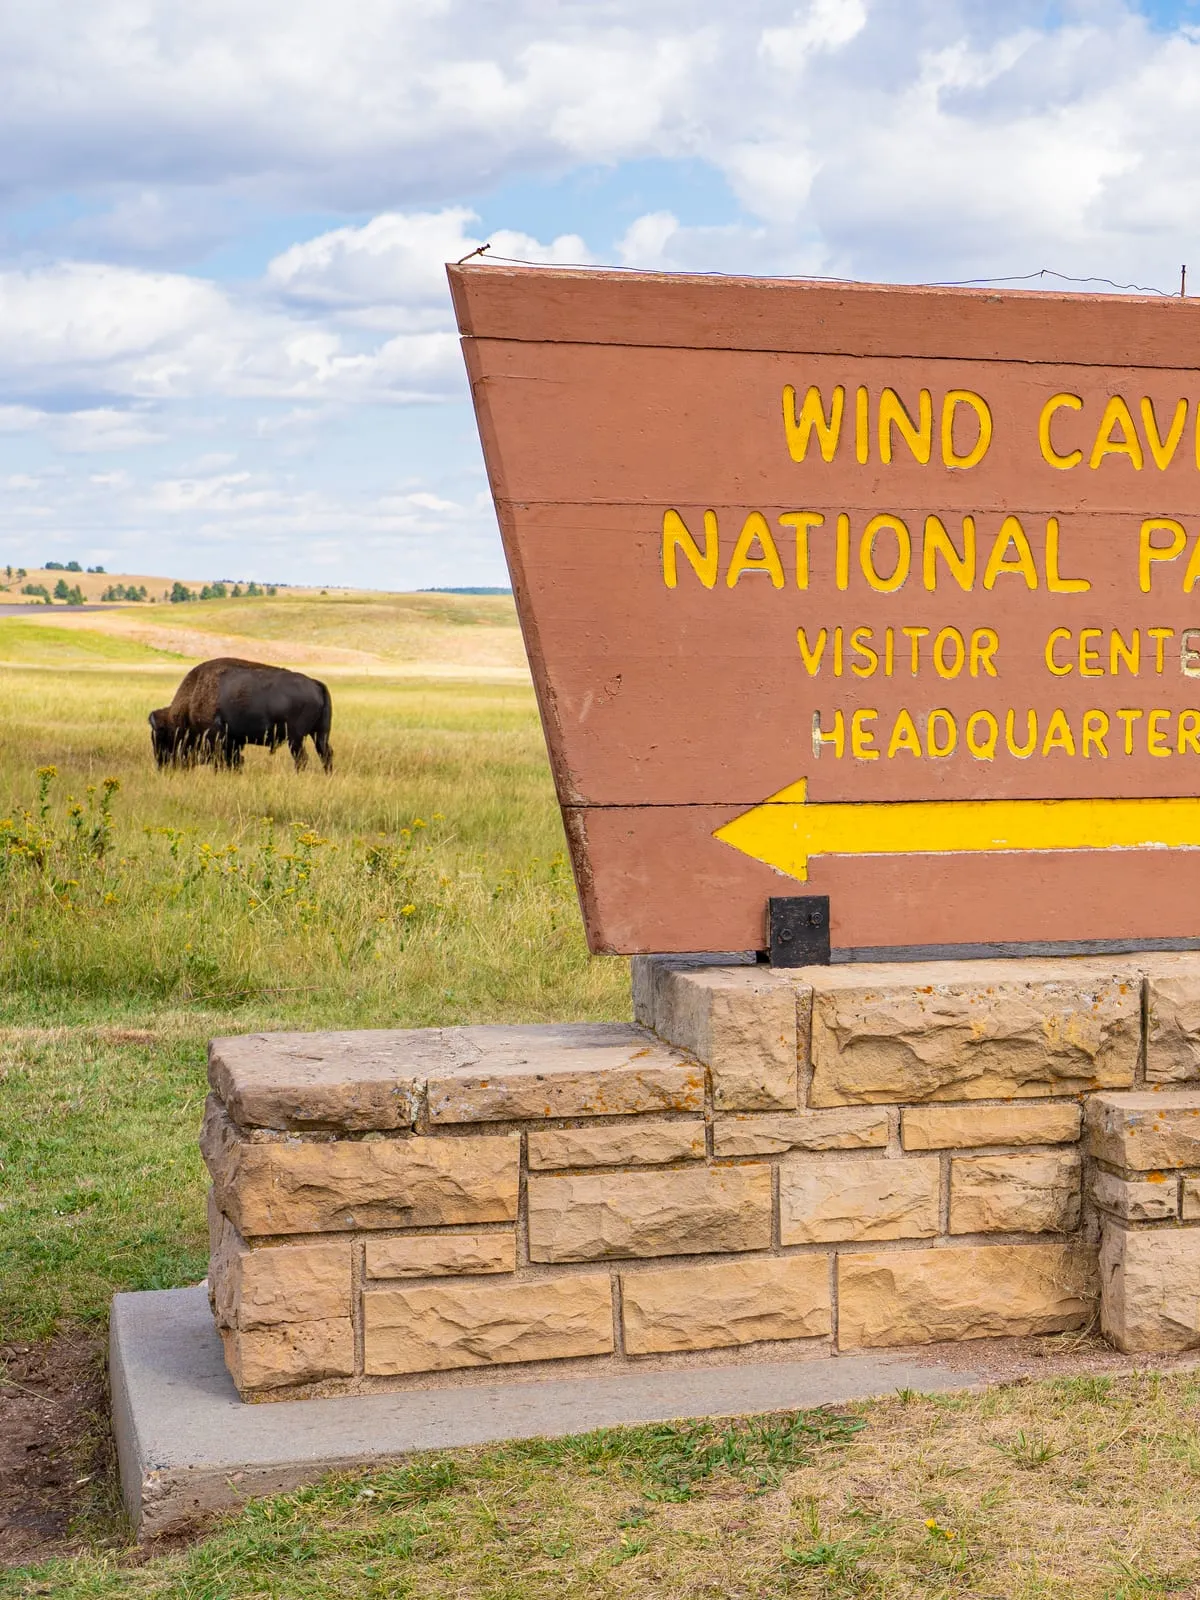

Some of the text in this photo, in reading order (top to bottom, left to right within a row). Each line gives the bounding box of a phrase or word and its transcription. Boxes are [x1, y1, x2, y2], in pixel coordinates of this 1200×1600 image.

[782, 384, 993, 469] WIND
[661, 508, 1092, 593] NATIONAL
[797, 626, 1000, 679] VISITOR
